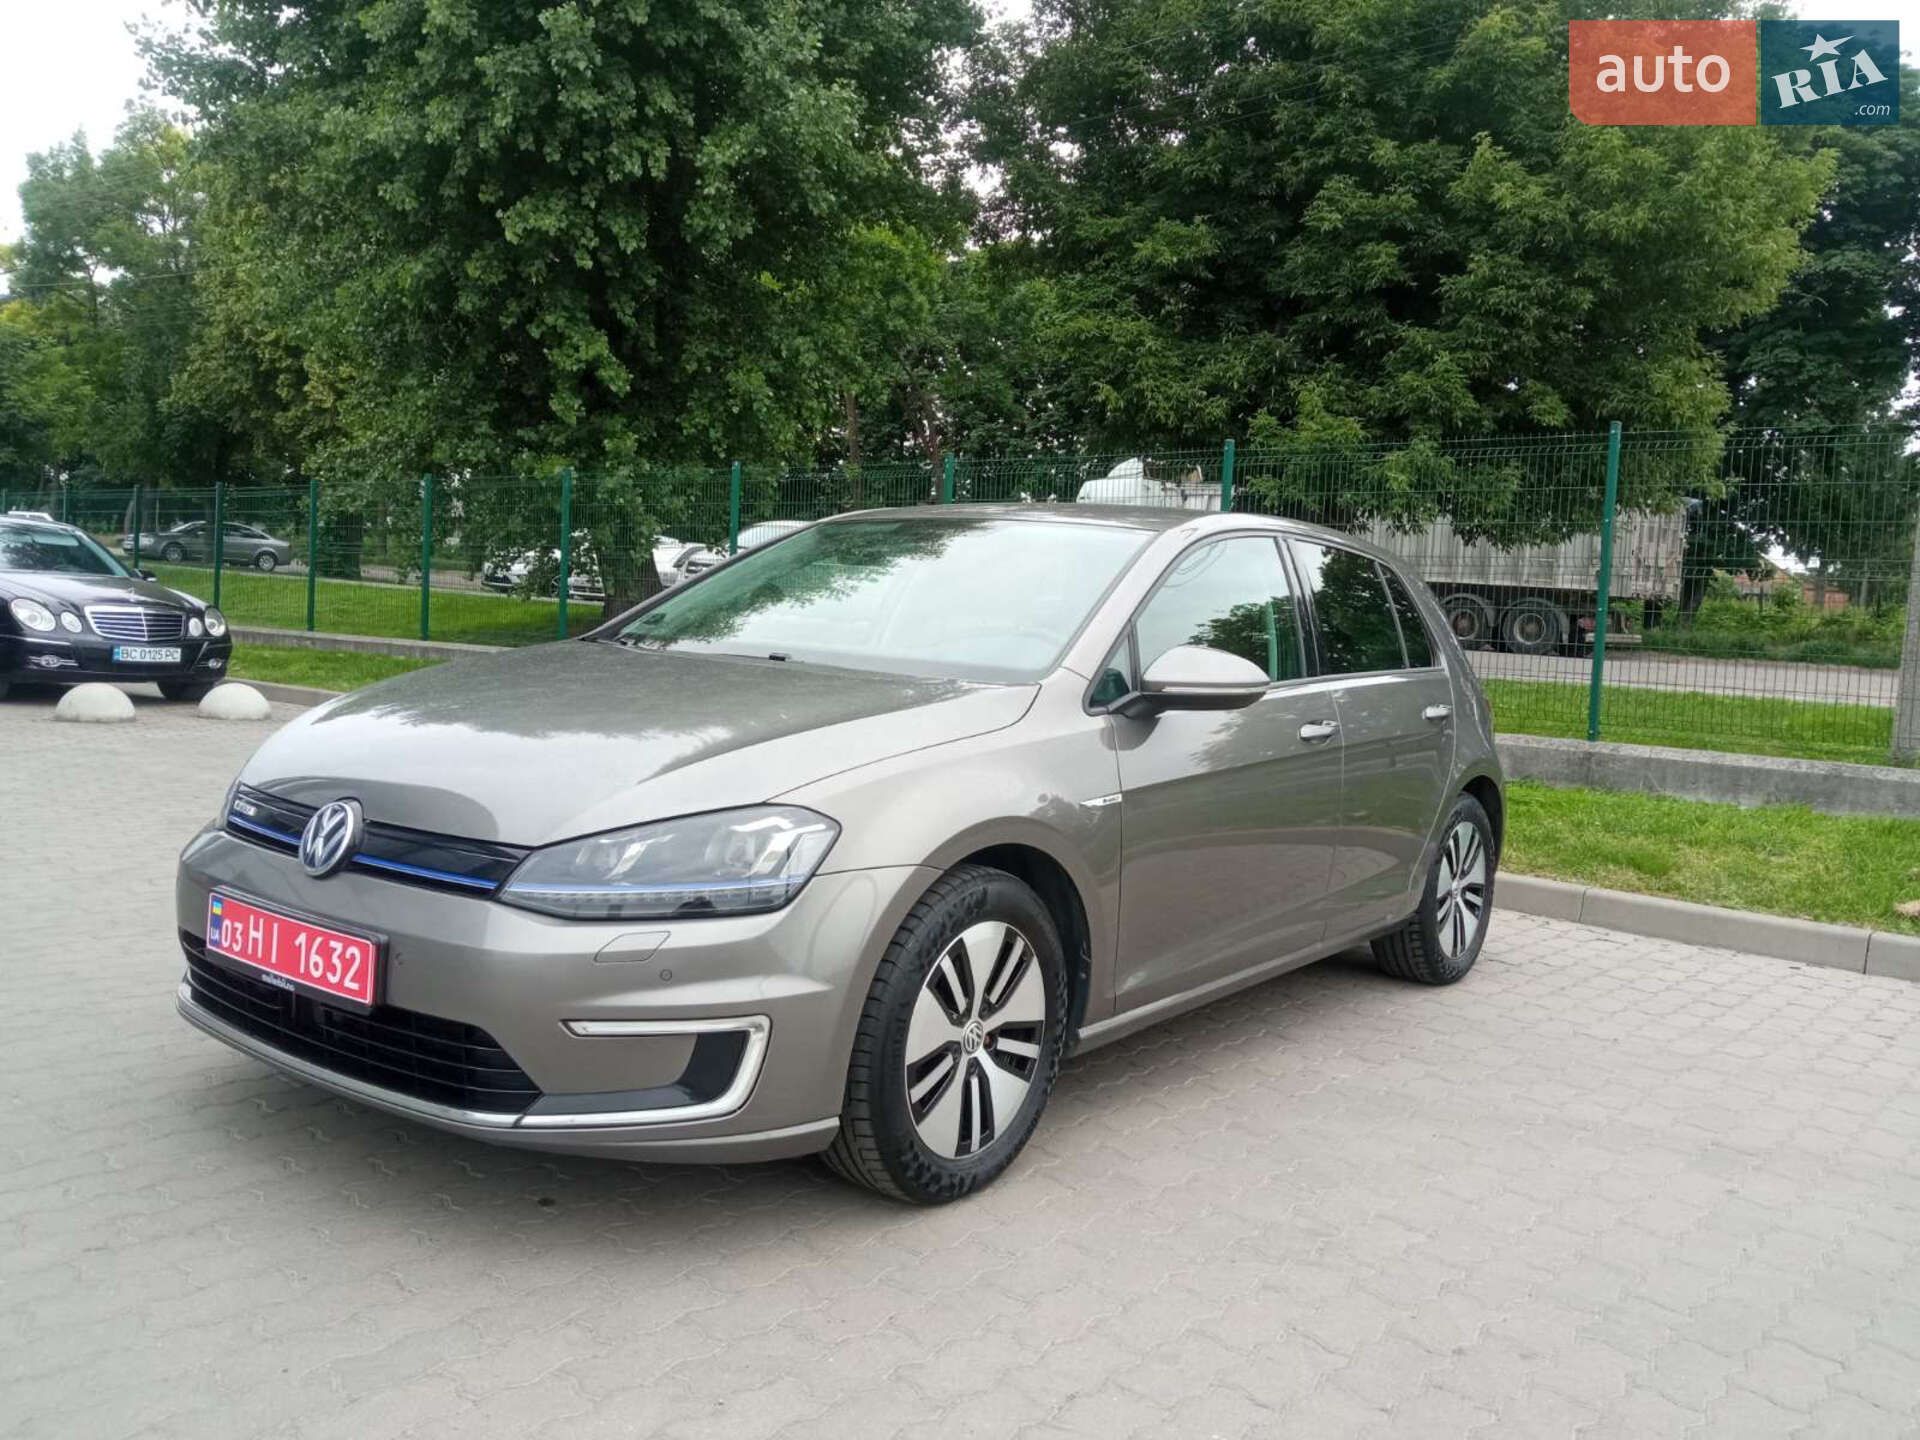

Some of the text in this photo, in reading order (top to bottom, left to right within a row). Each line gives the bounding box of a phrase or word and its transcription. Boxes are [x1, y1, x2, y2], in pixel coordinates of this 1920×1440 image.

[121, 648, 137, 660] BC
[140, 648, 163, 660] 0125
[301, 801, 354, 877] VW
[221, 914, 361, 990] 03 HI 1632
